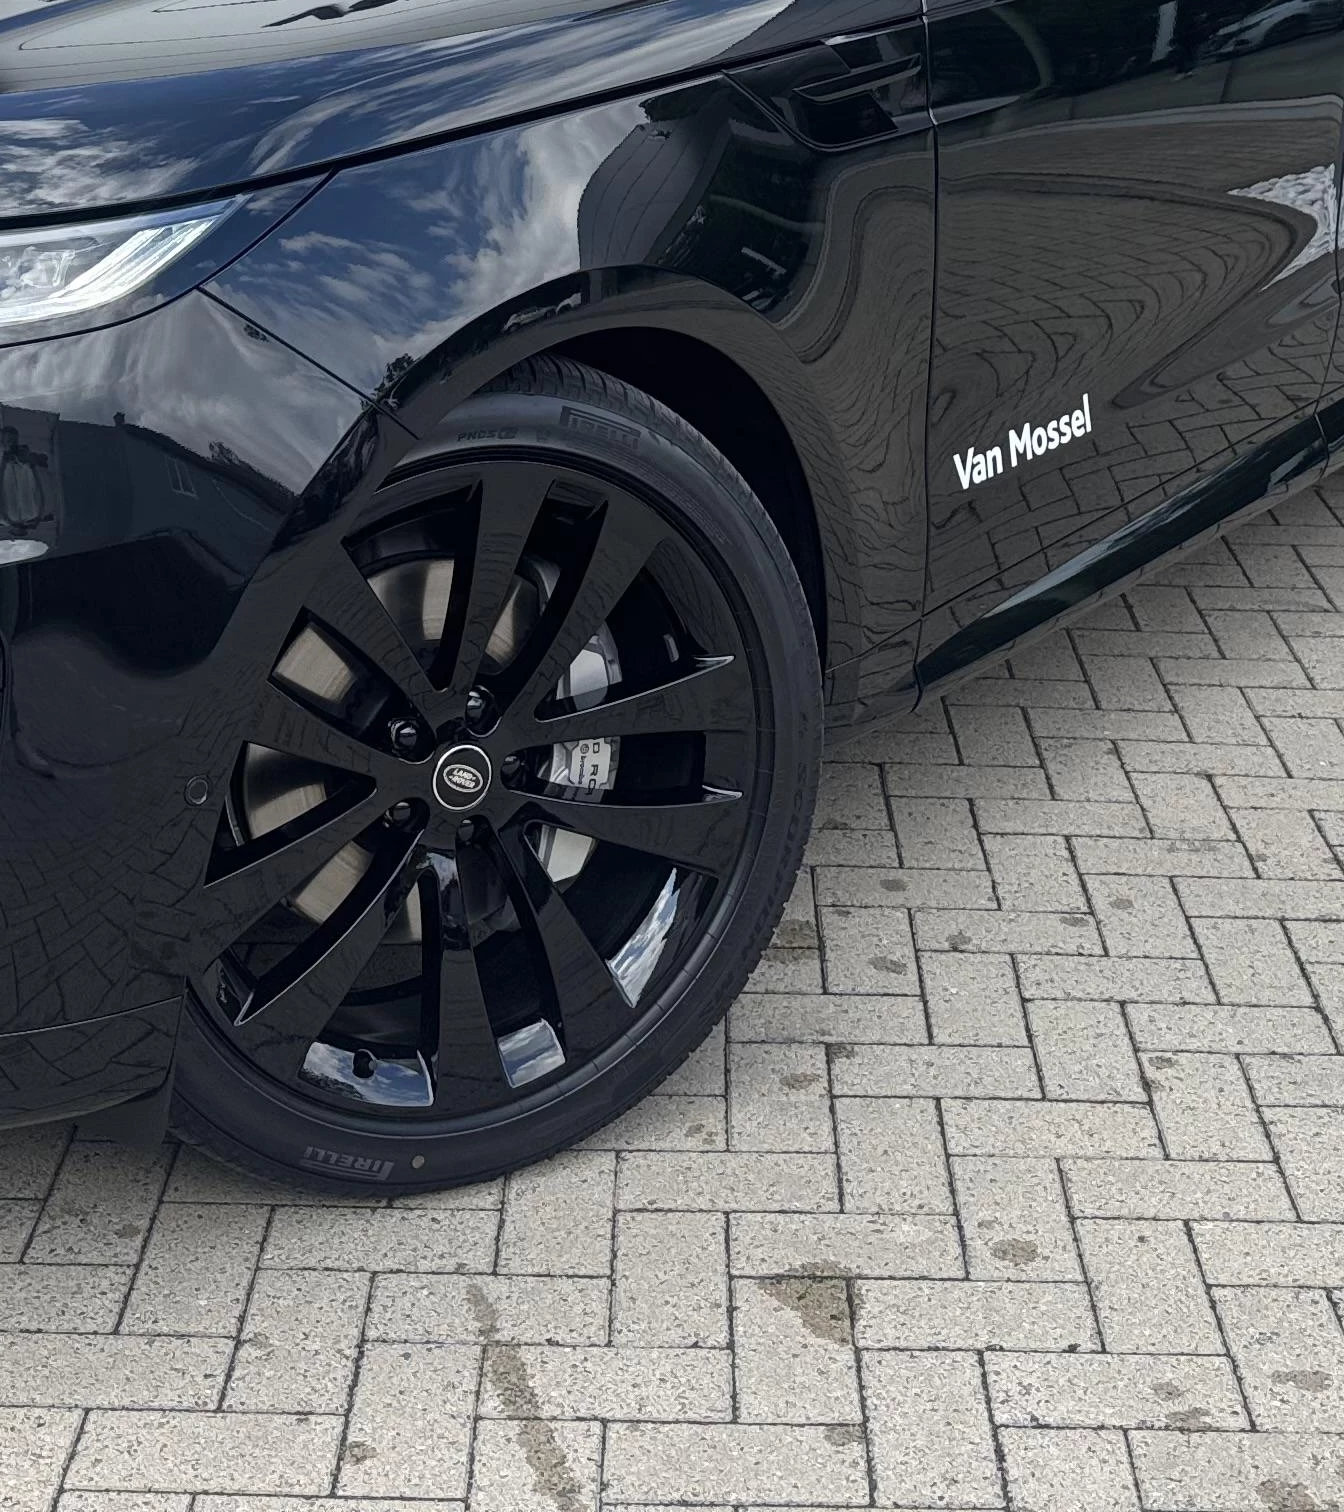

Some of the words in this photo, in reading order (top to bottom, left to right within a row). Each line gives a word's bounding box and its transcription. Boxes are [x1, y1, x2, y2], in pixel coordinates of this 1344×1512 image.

[952, 446, 1004, 490] Van
[1008, 392, 1092, 468] Mossel
[298, 1145, 395, 1180] PIRELLI
